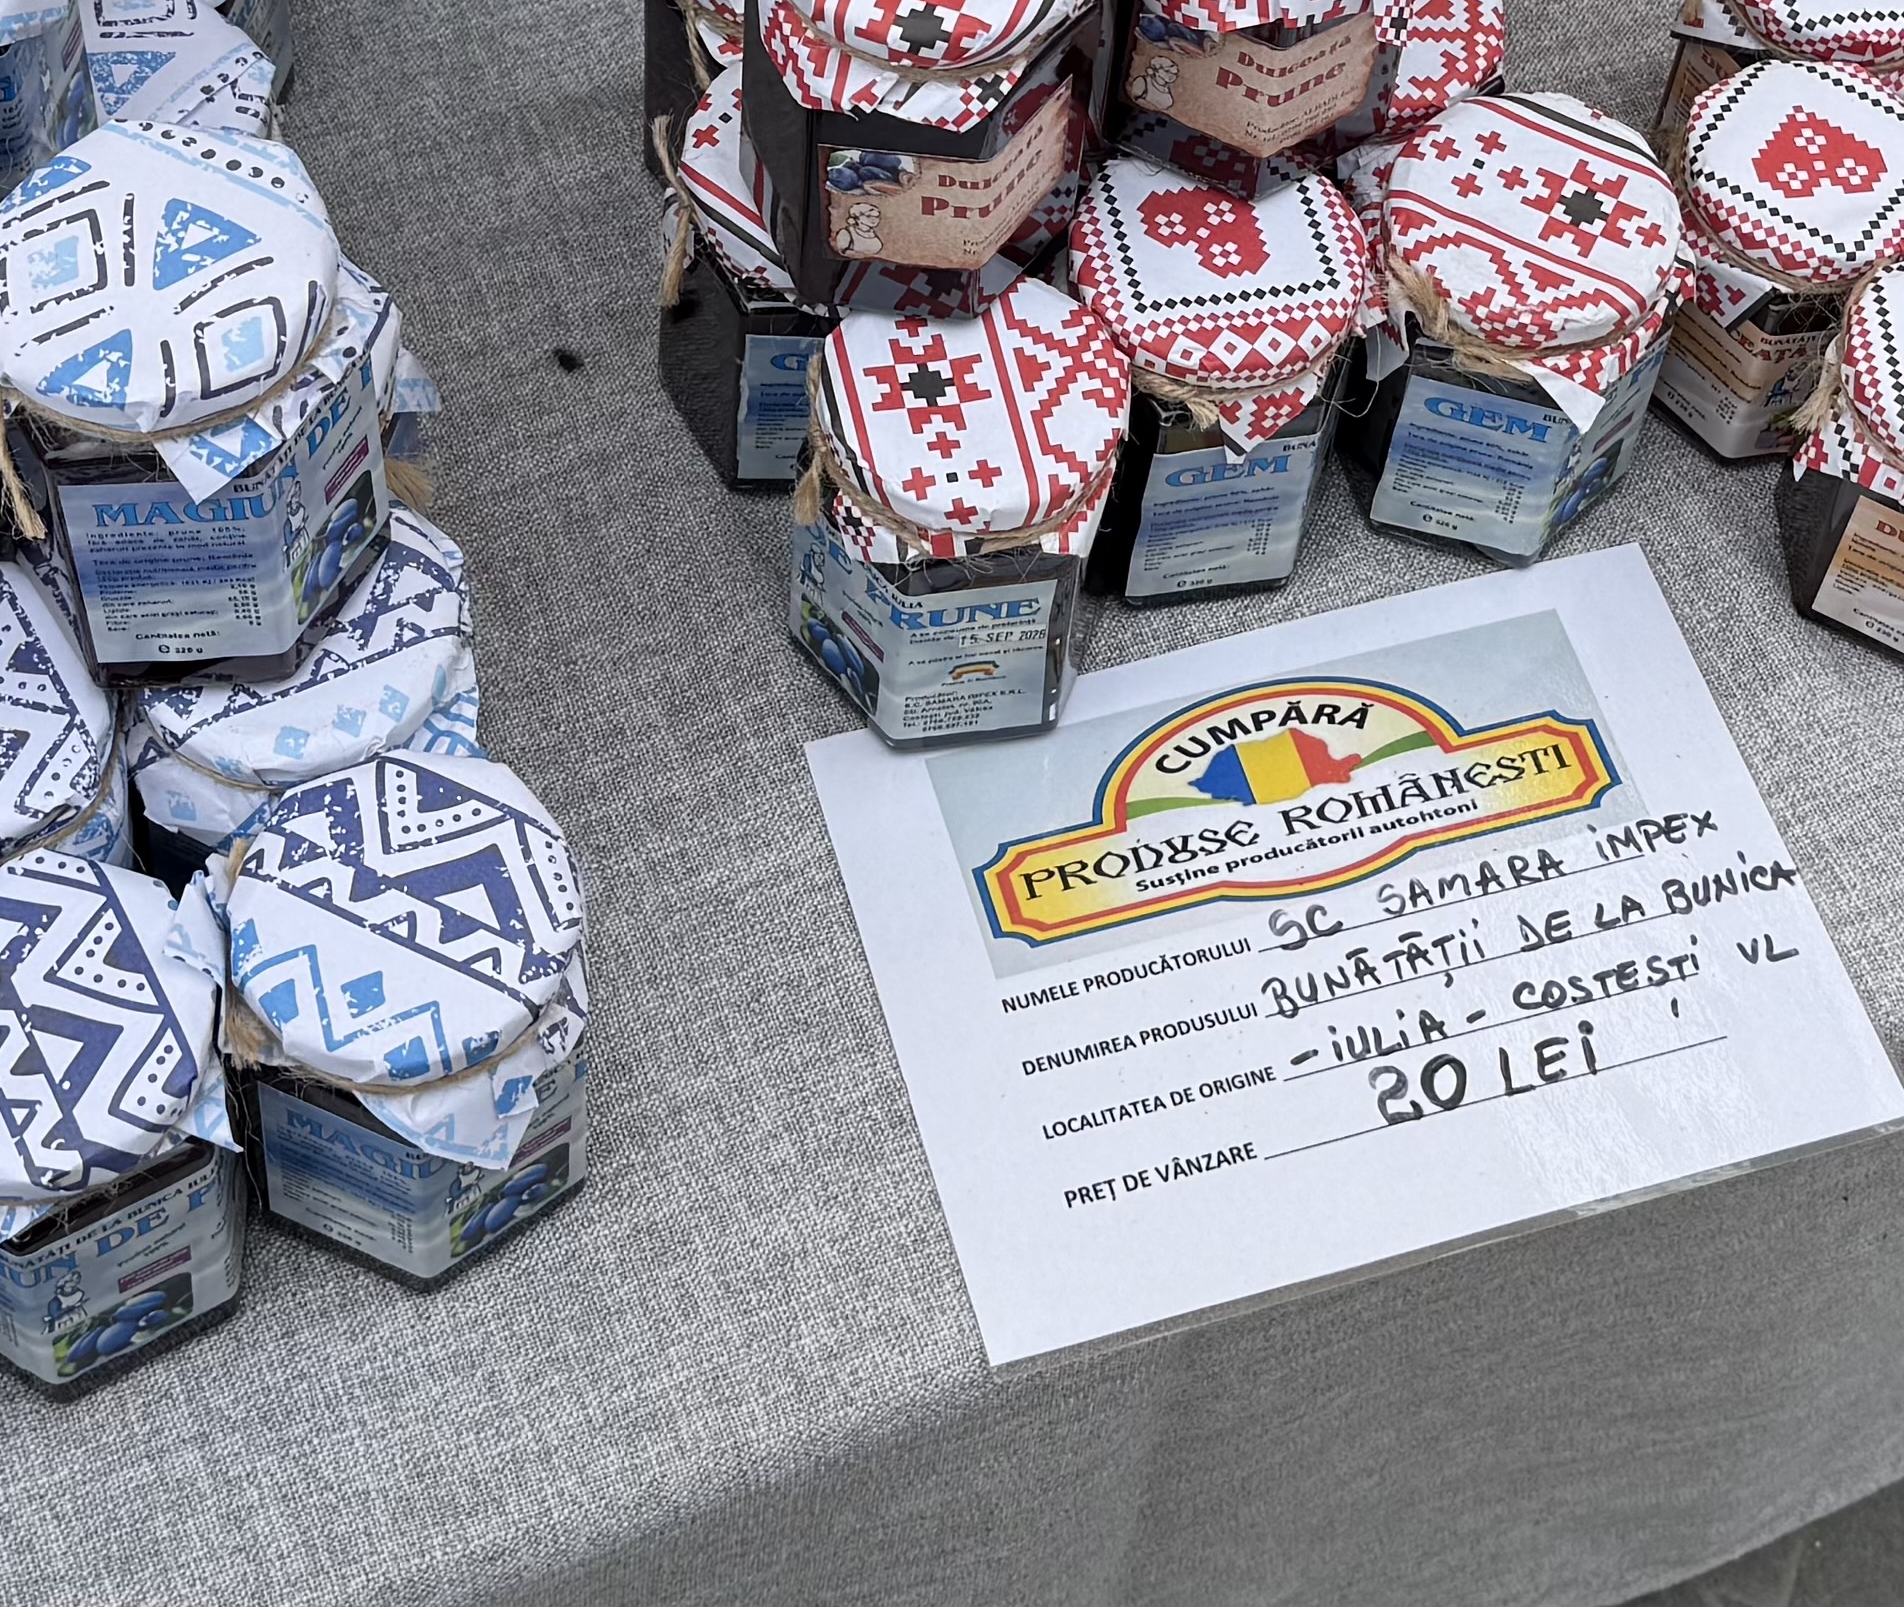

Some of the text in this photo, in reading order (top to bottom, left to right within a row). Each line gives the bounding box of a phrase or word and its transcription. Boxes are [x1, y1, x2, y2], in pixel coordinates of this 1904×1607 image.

[1216, 62, 1346, 108] Prune
[1424, 396, 1551, 443] GEM
[1165, 454, 1291, 487] GEM
[1154, 702, 1374, 775] CUMPĂRĂ
[1226, 826, 1364, 874] producătorii
[1369, 798, 1478, 837] autohtoni
[1001, 981, 1080, 1014] NUMELE
[1083, 937, 1252, 992] PRODUCĂTORULUI
[1376, 849, 1567, 916] SAMARA
[1586, 811, 1718, 863] IMPEX
[1022, 1035, 1137, 1076] DENUMIREA
[1139, 1002, 1258, 1045] PRODUSULUI
[1518, 909, 1574, 952] DE
[1594, 894, 1647, 930] LA
[1660, 852, 1798, 916] BUNICA
[1042, 1095, 1167, 1140] LOCALITATEA
[1169, 1086, 1196, 1106] DE
[1198, 1066, 1277, 1099] ORIGINE
[1735, 933, 1799, 965] VL
[1064, 1021, 1600, 1208] PREȚ DE VÂNZARE 20 LEI
